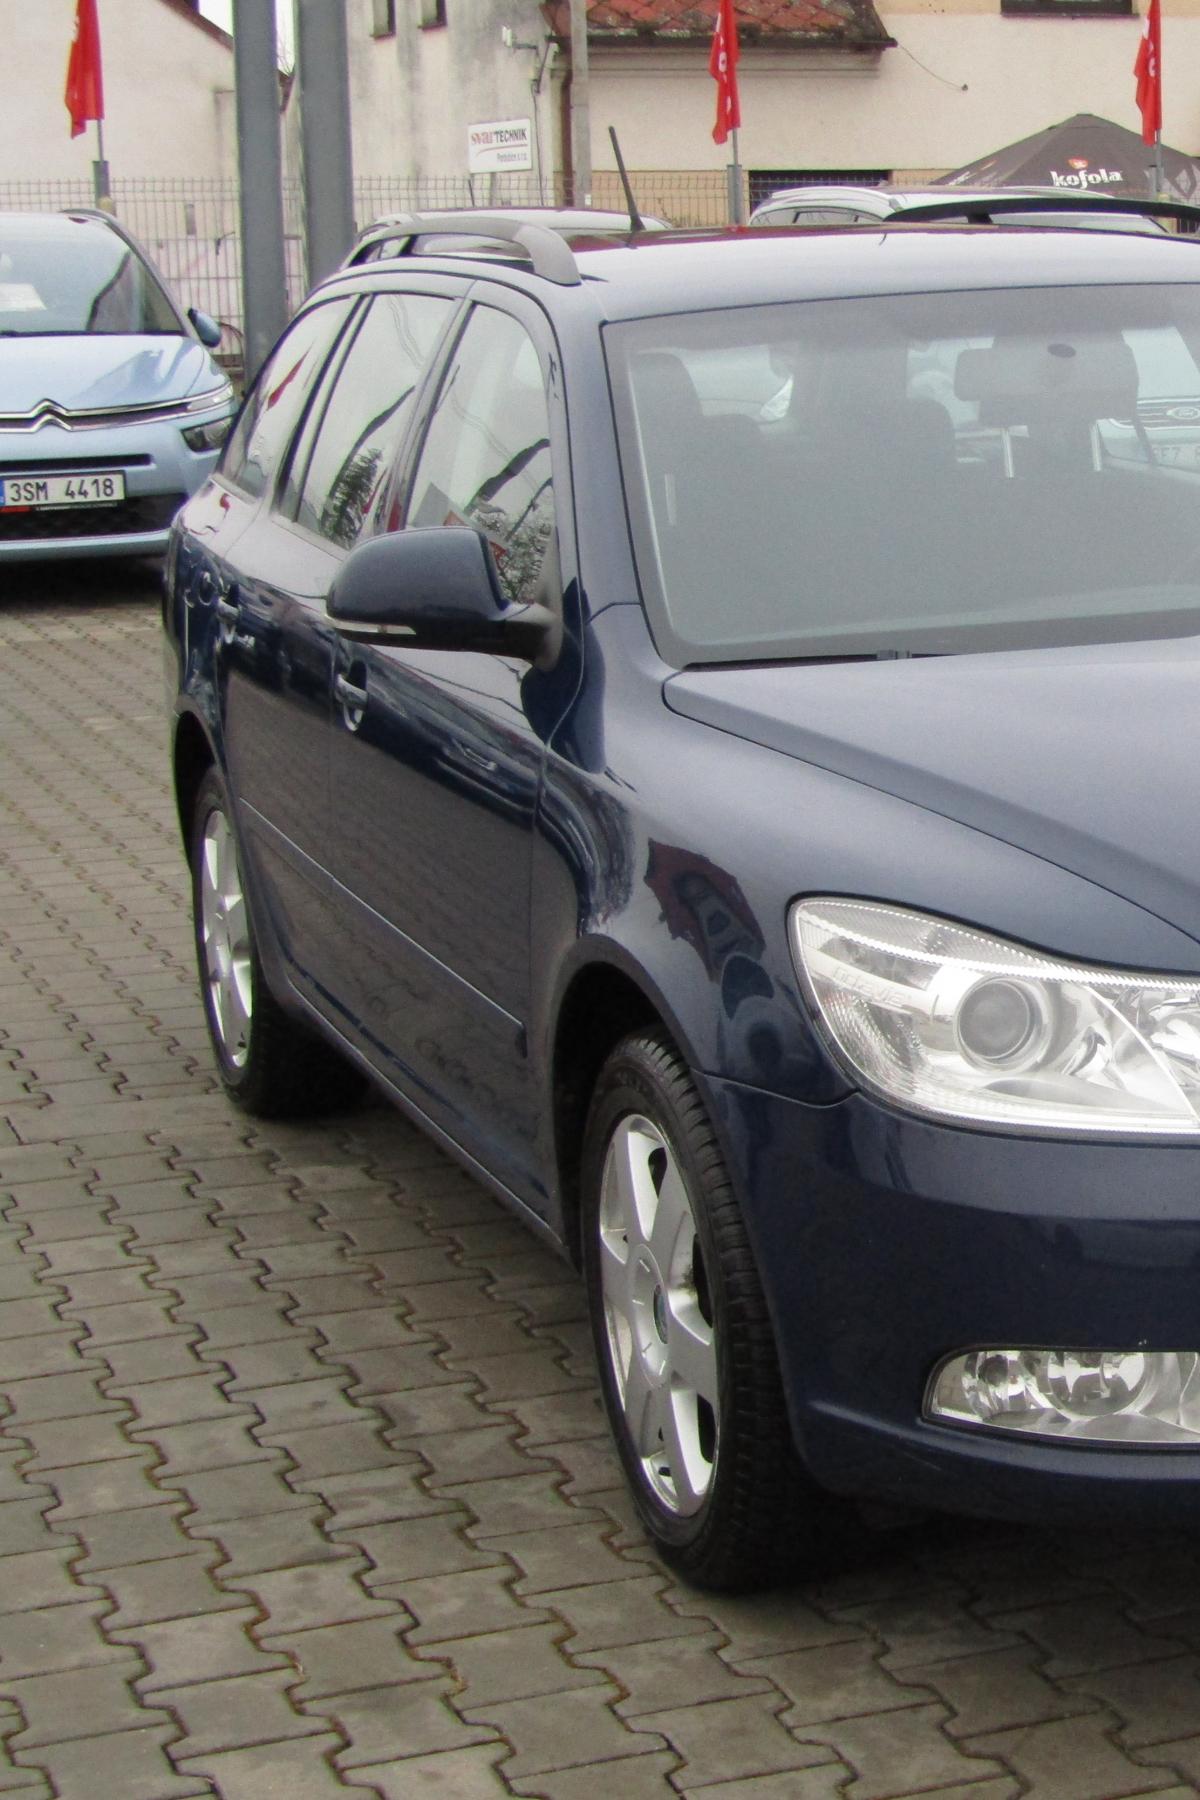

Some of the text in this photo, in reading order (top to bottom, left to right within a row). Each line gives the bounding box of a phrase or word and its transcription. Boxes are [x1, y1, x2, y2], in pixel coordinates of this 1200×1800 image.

[1050, 168, 1123, 189] kofola
[10, 478, 114, 502] 3SM 4418
